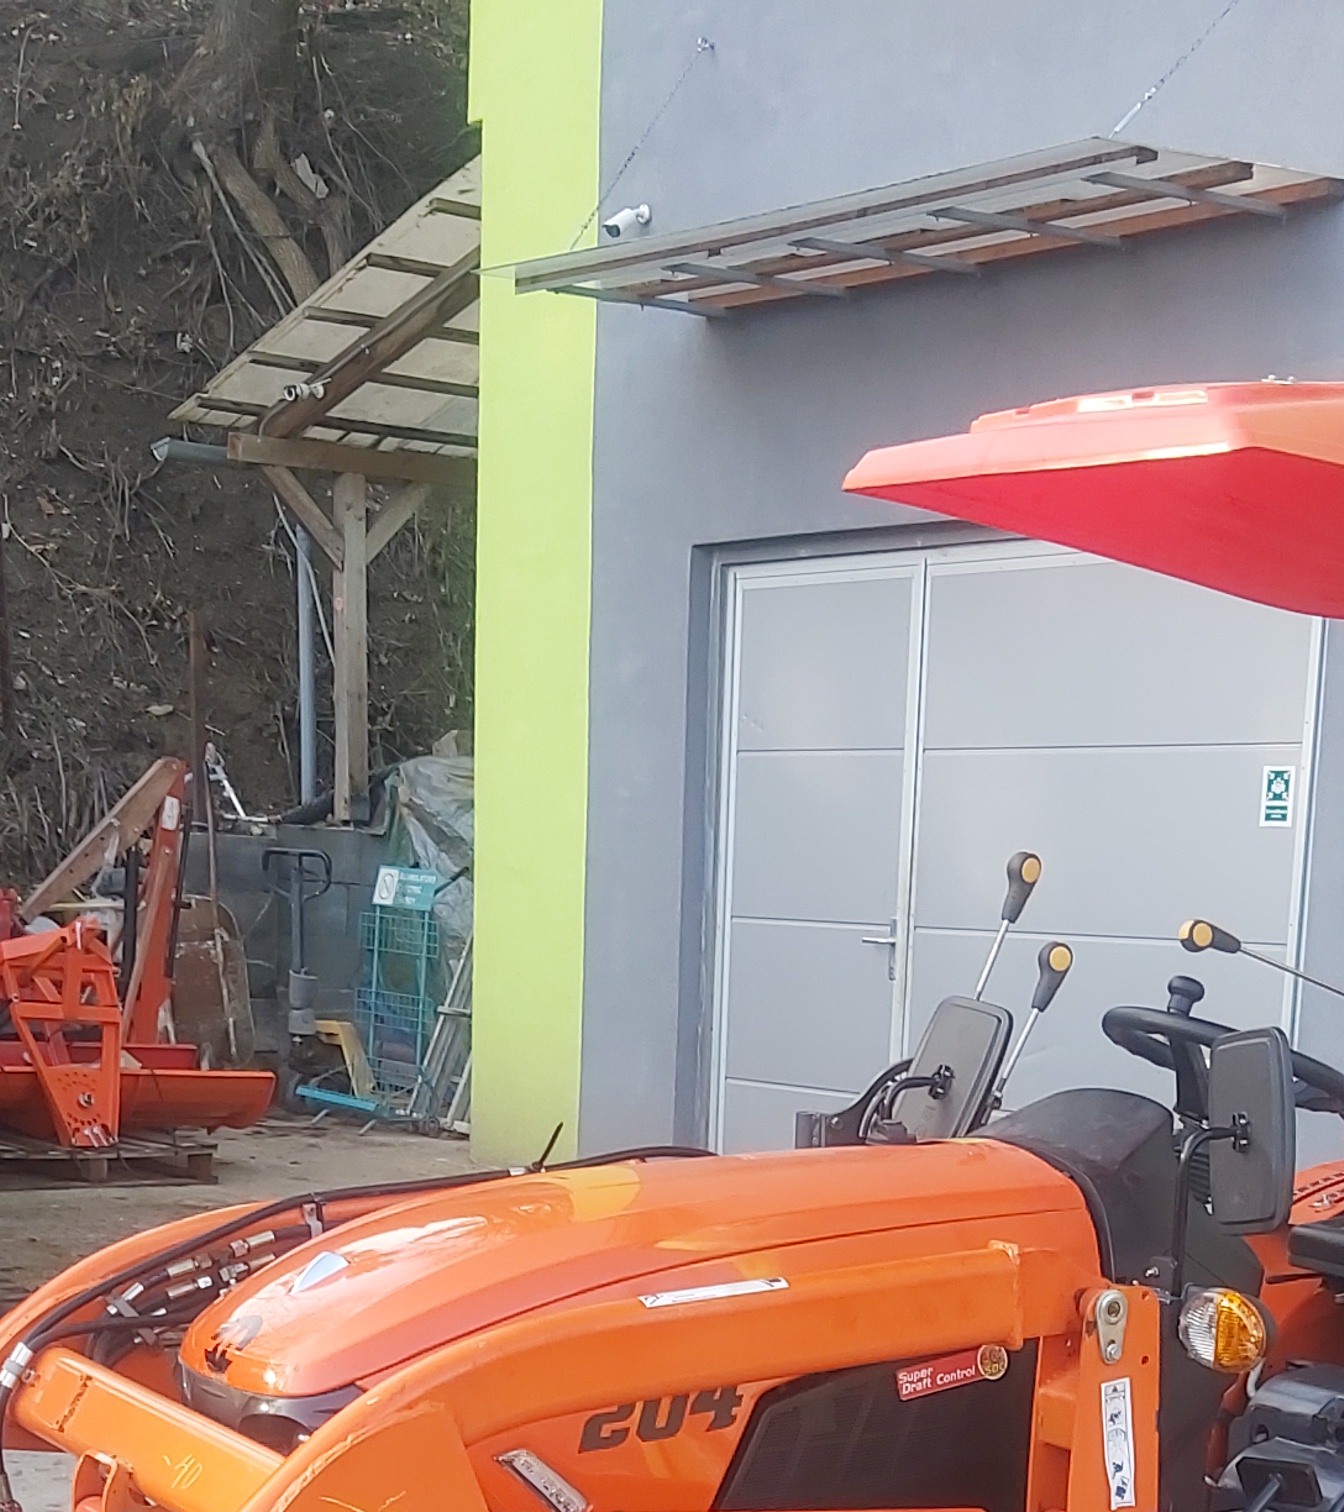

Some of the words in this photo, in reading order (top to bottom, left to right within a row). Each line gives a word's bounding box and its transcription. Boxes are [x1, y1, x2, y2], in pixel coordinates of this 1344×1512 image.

[899, 1367, 933, 1384] Super
[902, 1378, 931, 1395] Draft
[936, 1365, 976, 1385] Control
[578, 1386, 743, 1454] 204
